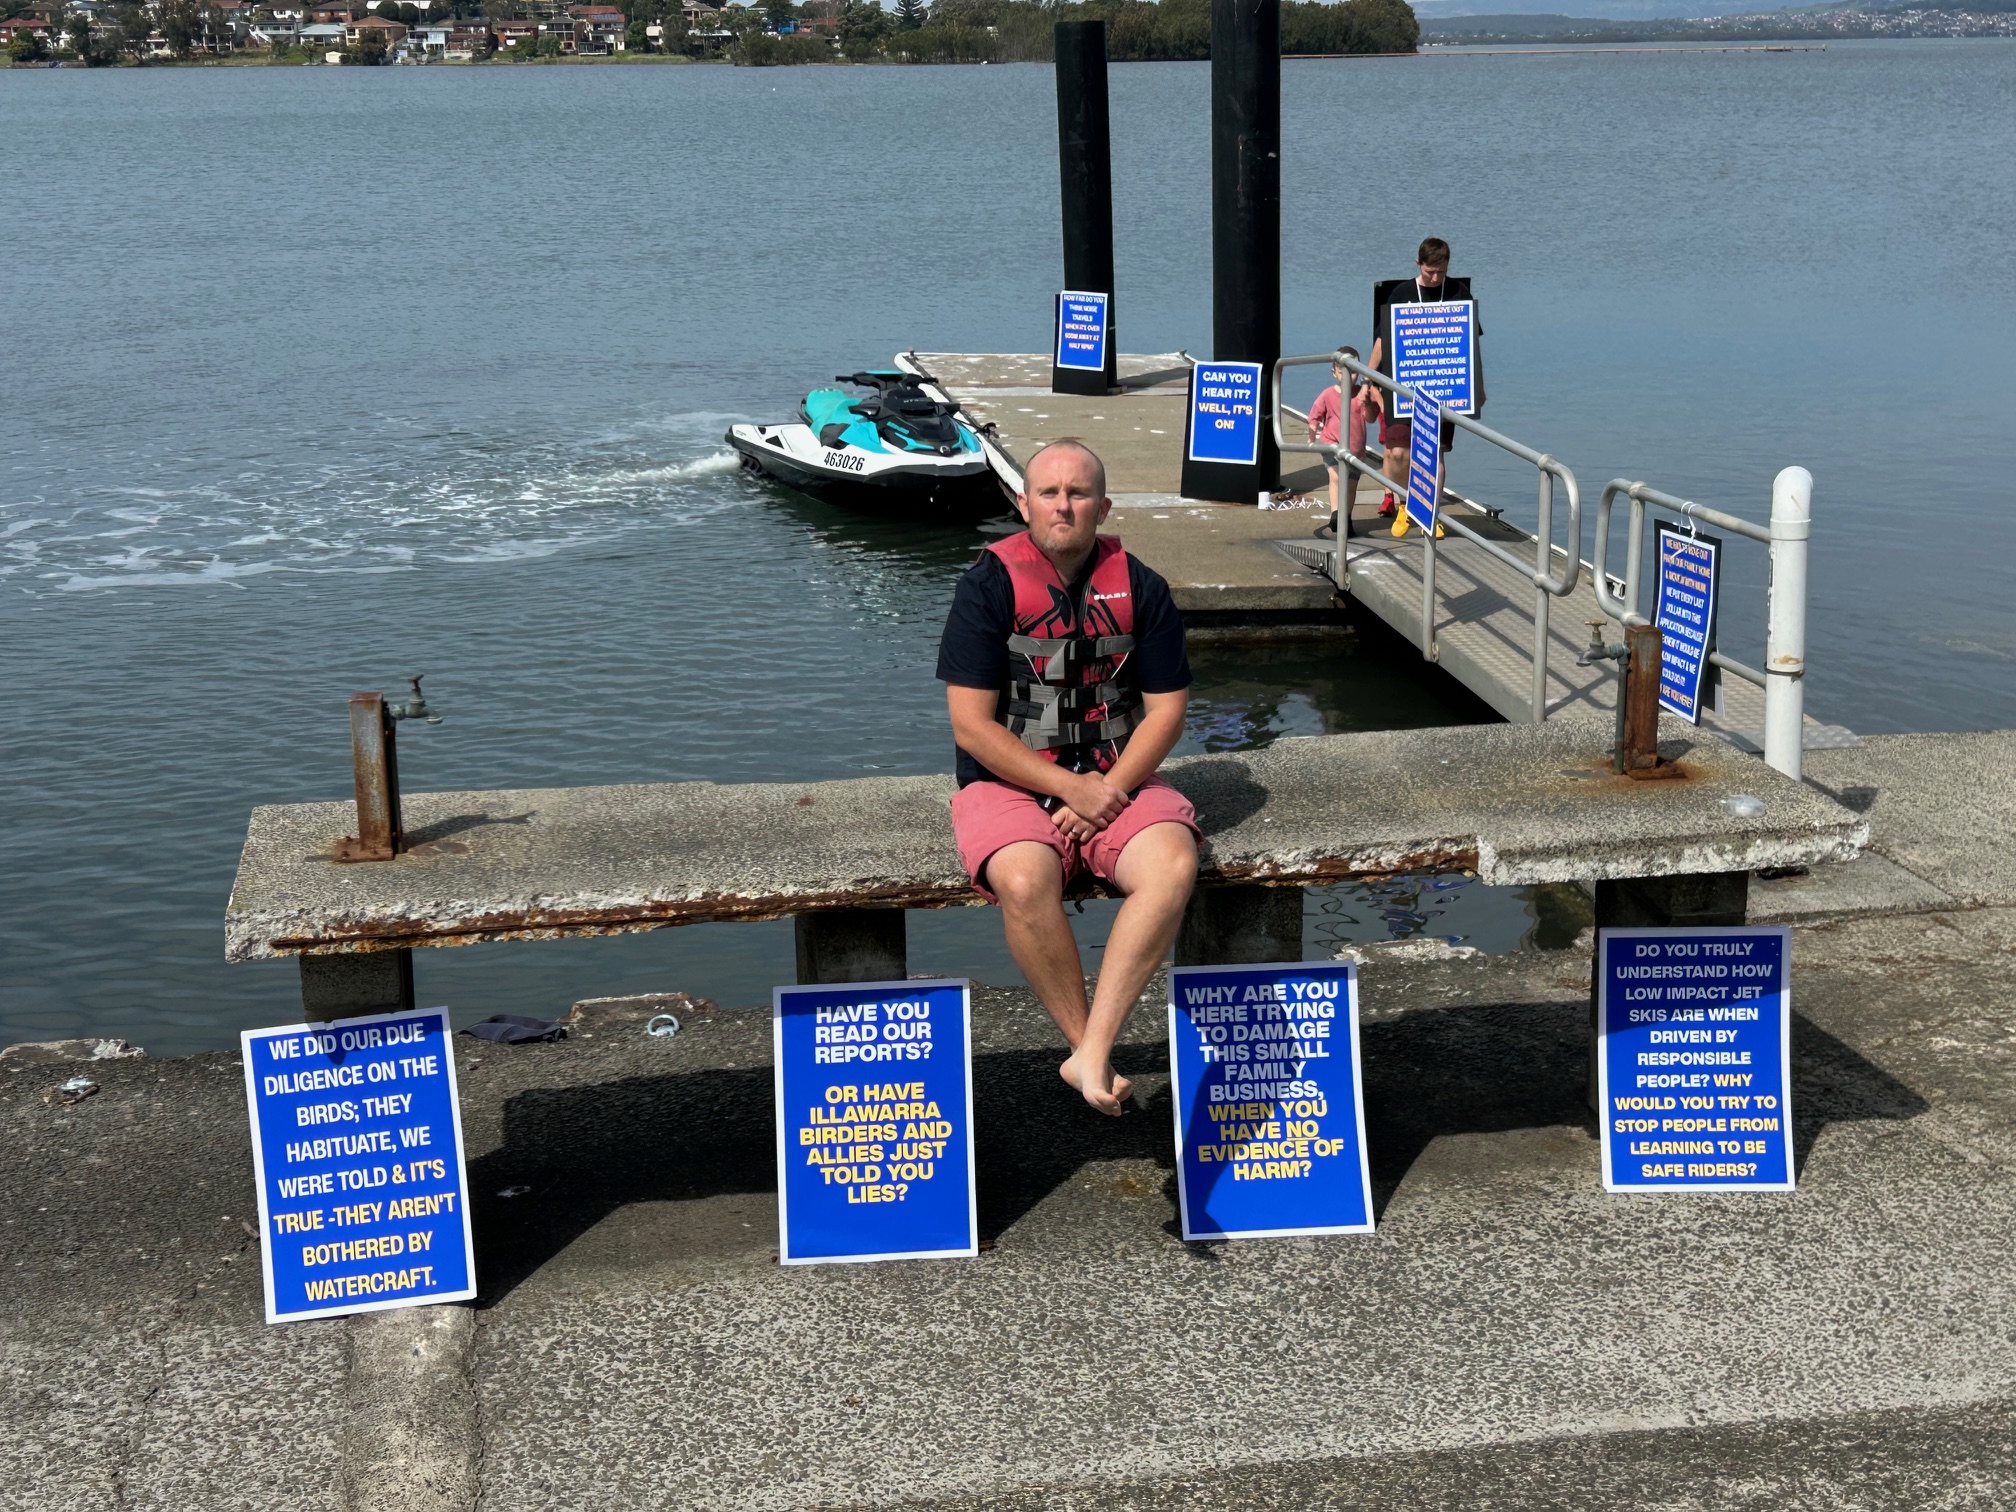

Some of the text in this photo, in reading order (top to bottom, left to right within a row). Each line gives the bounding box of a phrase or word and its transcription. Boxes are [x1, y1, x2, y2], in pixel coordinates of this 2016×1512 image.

[1202, 371, 1251, 383] CAN YOU
[1202, 387, 1250, 399] HEAR IT?
[1198, 402, 1253, 415] WELL, IT'S
[1214, 419, 1234, 429] ON!
[824, 452, 865, 472] 463026
[1635, 942, 1754, 957] DO YOU TRULY
[1616, 964, 1772, 978] UNDERSTAND HOW
[1185, 982, 1338, 1004] WHY ARE YOU
[1626, 986, 1762, 1000] LOW IMPACT JET
[816, 1002, 929, 1023] HAVE YOU
[1190, 1002, 1335, 1024] HERE TRYING
[1629, 1008, 1758, 1021] SKIS ARE WHEN
[268, 1023, 425, 1060] WE DID OUR DUE
[815, 1022, 931, 1043] READ OUR
[1197, 1022, 1329, 1043] TO DAMAGE
[1650, 1030, 1737, 1043] DRIVEN BY
[815, 1041, 933, 1063] REPORTS?
[1199, 1041, 1329, 1062] THIS SMALL
[1637, 1051, 1751, 1065] RESPONSIBLE
[264, 1055, 438, 1095] DILIGENCE ON THE
[1225, 1062, 1306, 1081] FAMILY
[1636, 1073, 1752, 1087] PEOPLE? WHY
[824, 1081, 924, 1104] OR HAVE
[1210, 1081, 1323, 1102] BUSINESS,
[296, 1093, 412, 1126] BIRDS; THEY
[810, 1101, 941, 1125] ILLAWARRA
[1208, 1100, 1327, 1122] WHEN YOU
[1614, 1095, 1777, 1110] WOULD YOU TRY TO
[799, 1120, 952, 1145] BIRDERS AND
[1220, 1120, 1319, 1141] HAVE NO
[1614, 1117, 1778, 1133] STOP PEOPLE FROM
[286, 1126, 430, 1162] HABITUATE, WE
[806, 1140, 946, 1165] ALLIES JUST
[1198, 1139, 1343, 1162] EVIDENCE OF
[1630, 1140, 1766, 1155] LEARNING TO BE
[278, 1158, 445, 1198] WERE TOLD & IT'S
[820, 1162, 934, 1184] TOLD YOU
[1234, 1160, 1312, 1181] HARM?
[1641, 1162, 1757, 1177] SAFE RIDERS?
[847, 1183, 908, 1203] LIES?
[273, 1192, 456, 1234] TRUE -THEY AREN'T
[302, 1230, 432, 1266] BOTHERED BY
[304, 1266, 436, 1301] WATERCRAFT.
